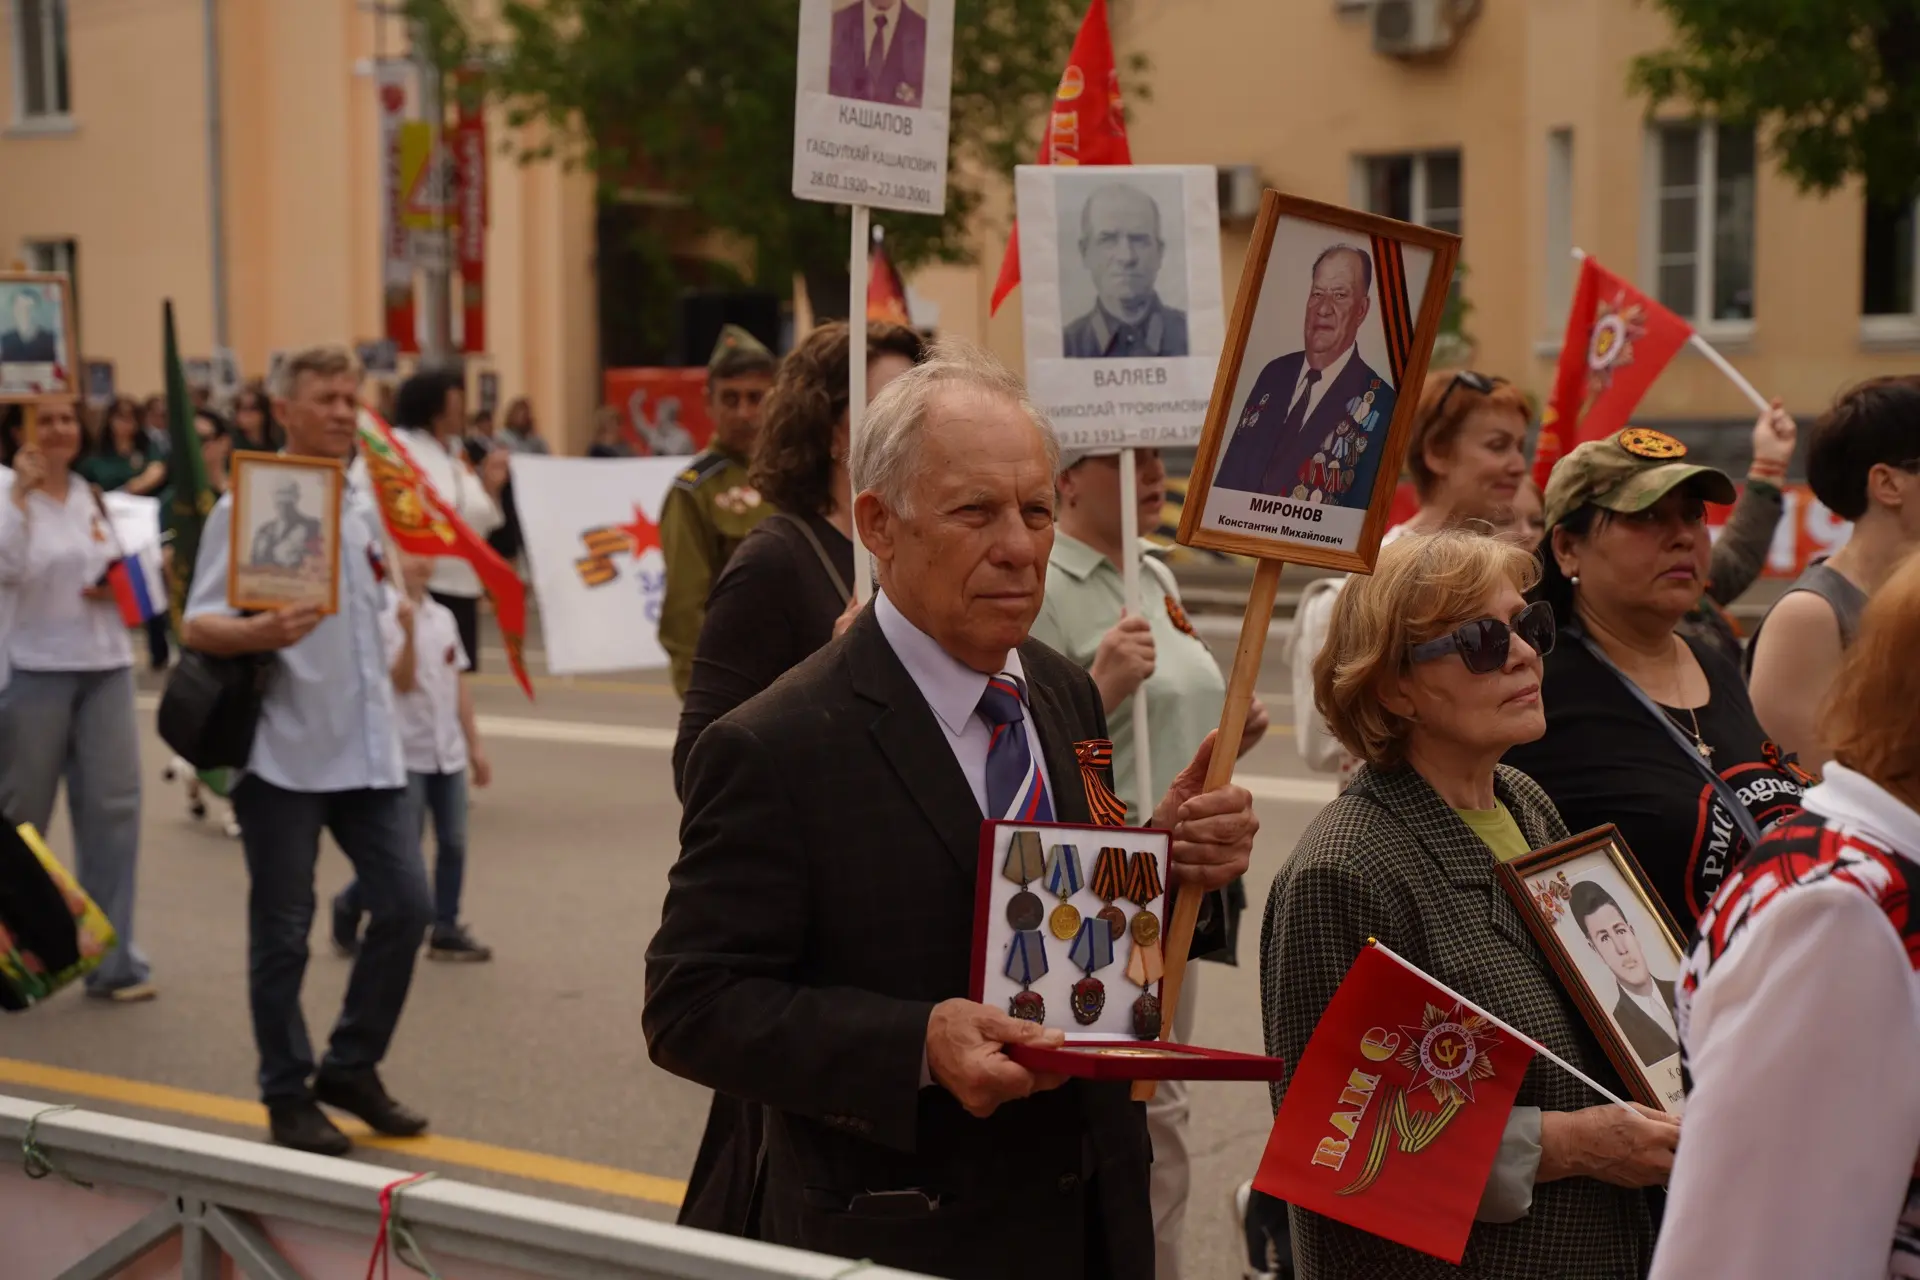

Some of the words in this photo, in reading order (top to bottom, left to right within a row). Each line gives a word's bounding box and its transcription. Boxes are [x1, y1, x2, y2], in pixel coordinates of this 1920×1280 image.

[838, 104, 913, 136] КАШАПОВ
[1093, 367, 1168, 387] ВАЛЯЕВ
[1249, 497, 1324, 523] МИРОНОВ
[1217, 514, 1278, 534] Константин
[1280, 525, 1343, 546] Михайлович
[1702, 804, 1735, 878] PMC
